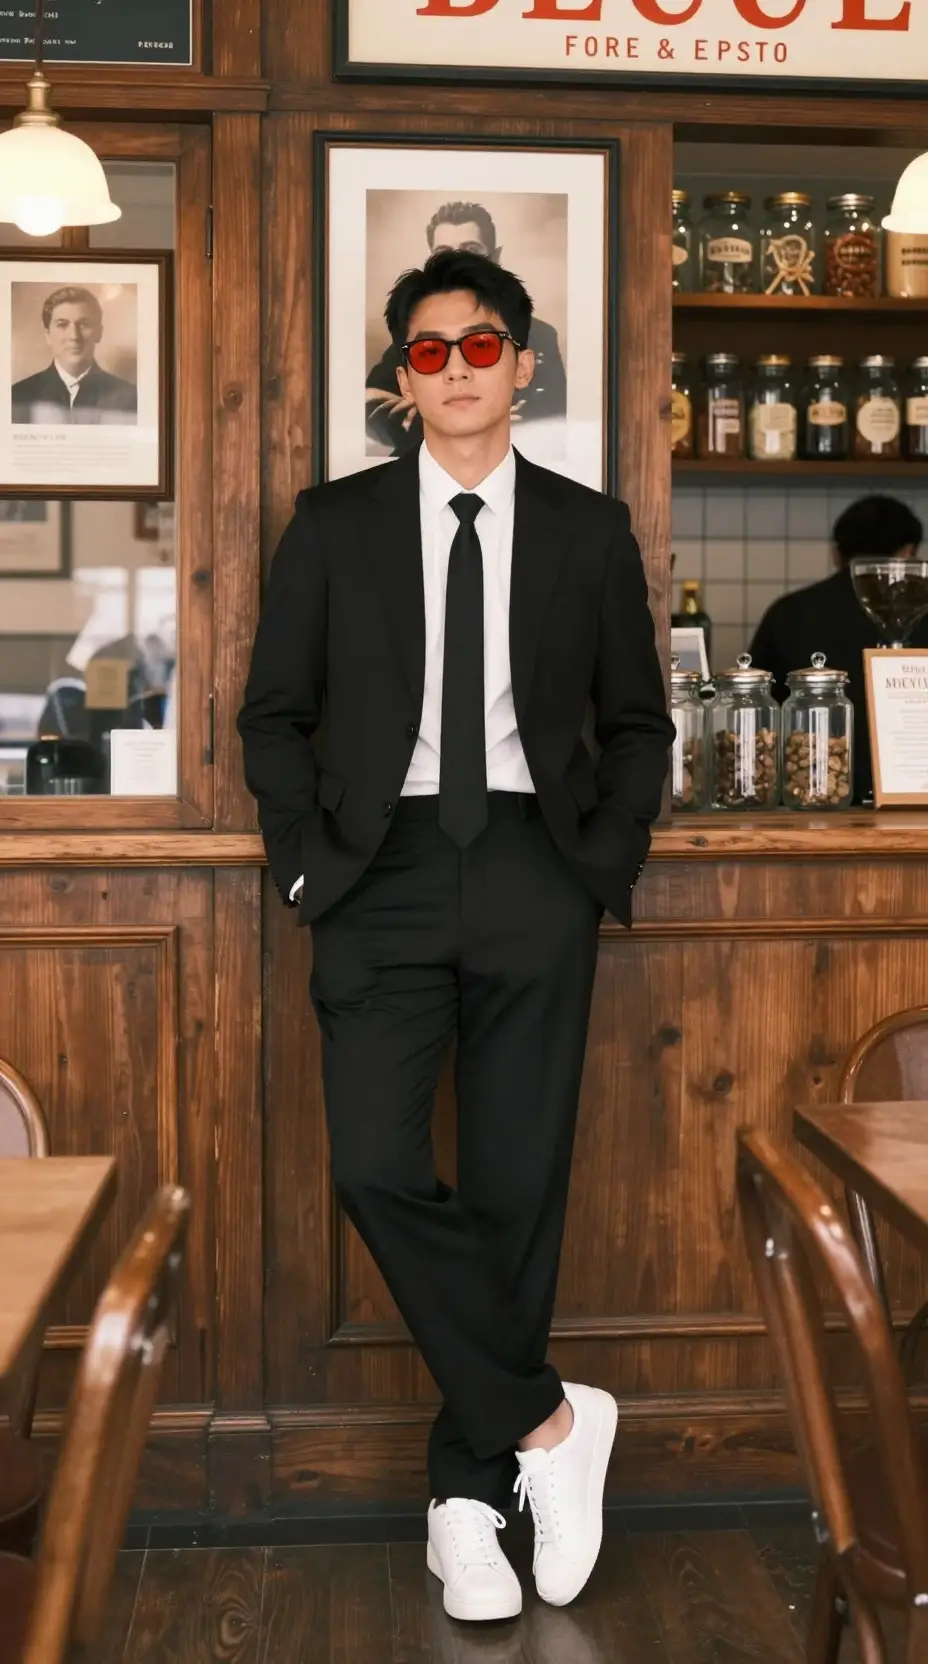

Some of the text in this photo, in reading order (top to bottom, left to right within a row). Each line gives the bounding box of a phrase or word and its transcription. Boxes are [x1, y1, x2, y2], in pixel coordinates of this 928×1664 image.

[565, 35, 787, 63] FORE & EPSTO
